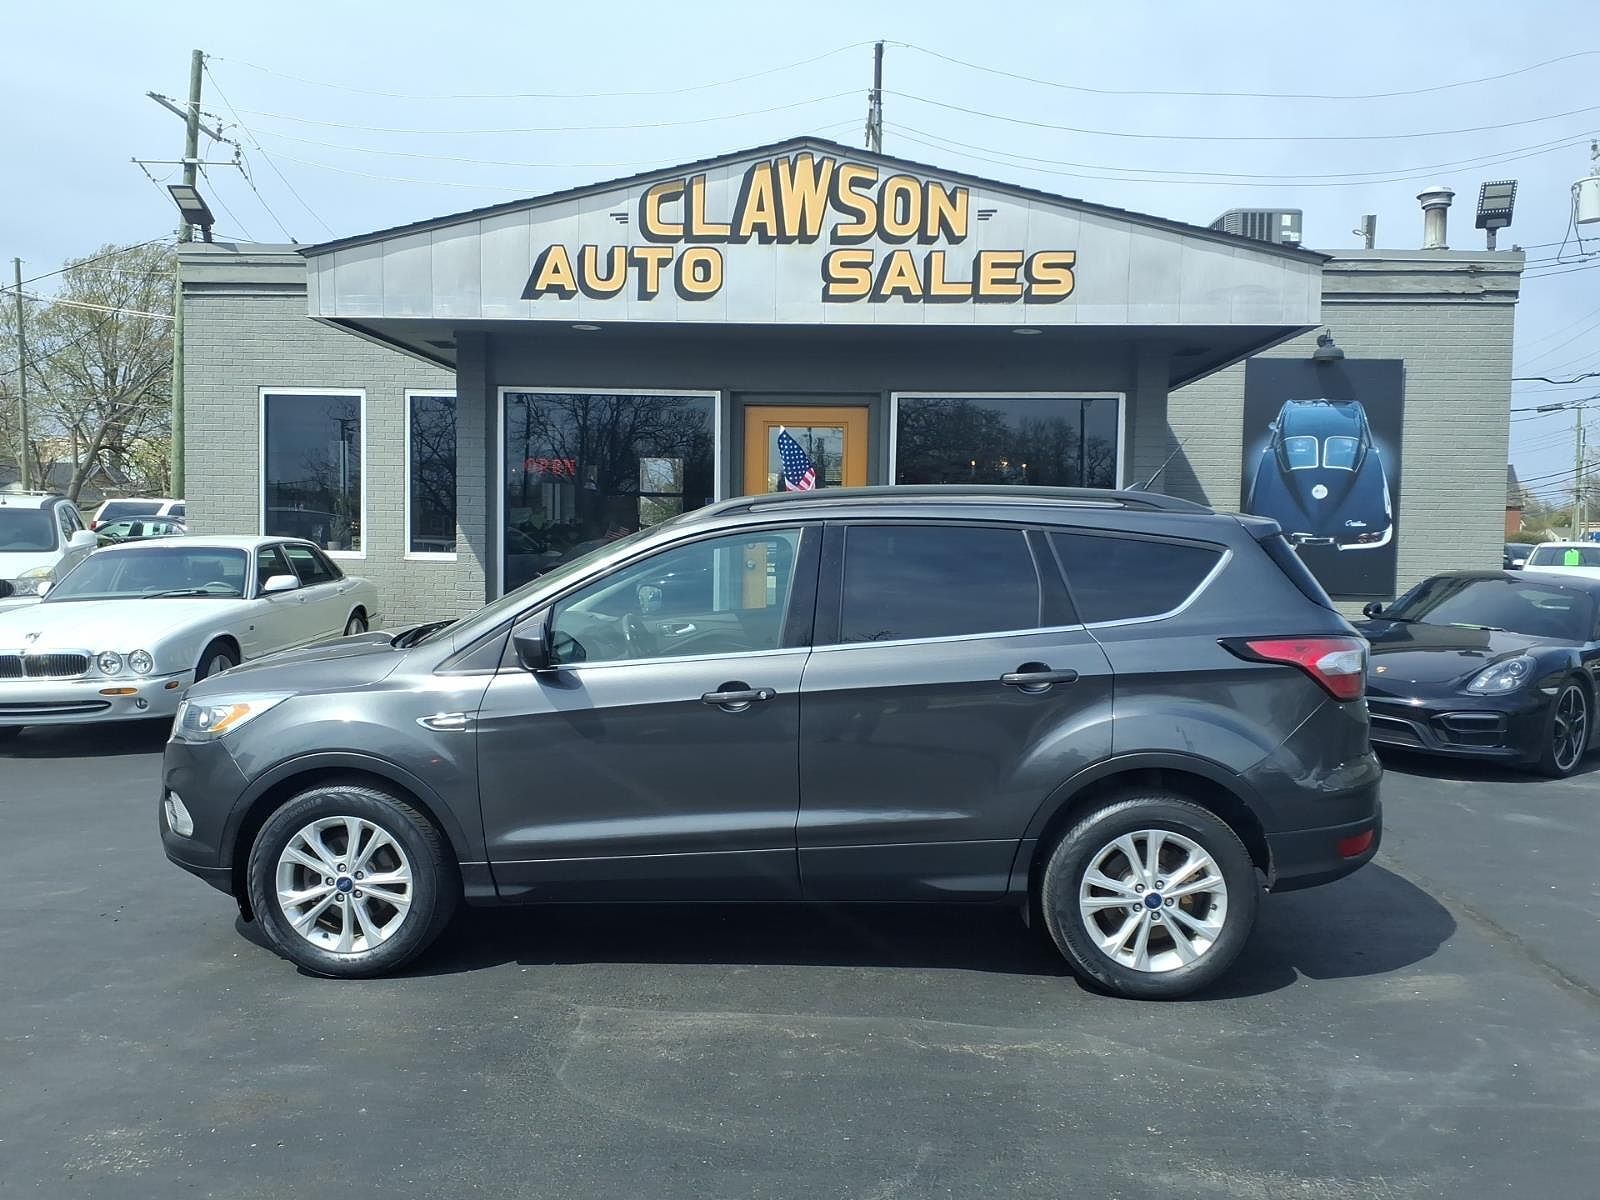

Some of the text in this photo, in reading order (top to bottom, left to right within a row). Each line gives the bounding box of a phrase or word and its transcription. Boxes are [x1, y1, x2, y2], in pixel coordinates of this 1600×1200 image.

[640, 151, 970, 244] CLAWSON
[522, 244, 1077, 303] AUTO SALES
[524, 457, 577, 477] OPEN
